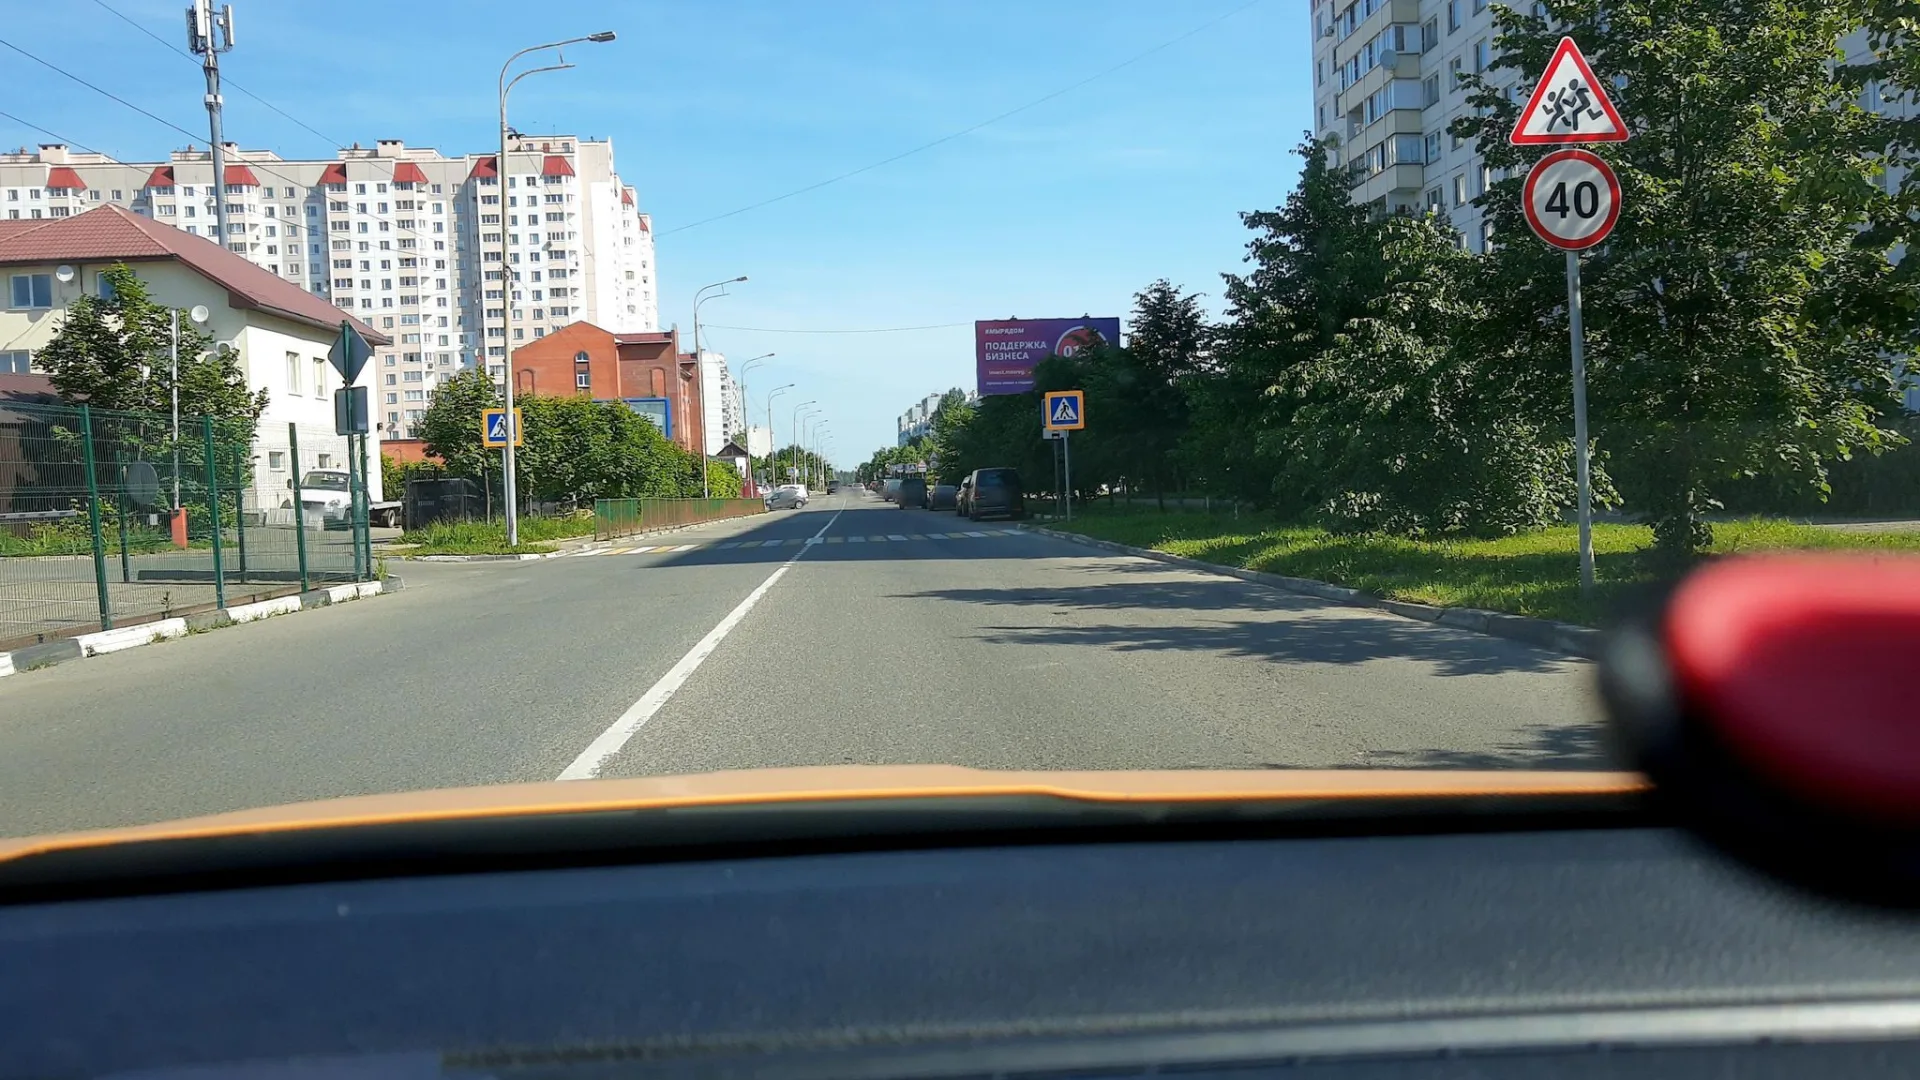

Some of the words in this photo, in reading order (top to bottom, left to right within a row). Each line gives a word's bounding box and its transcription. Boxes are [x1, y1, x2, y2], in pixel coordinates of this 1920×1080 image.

[1545, 181, 1599, 219] 40
[985, 340, 1047, 351] ПОДДЕРЖКА
[985, 351, 1029, 361] БИЗНЕСА
